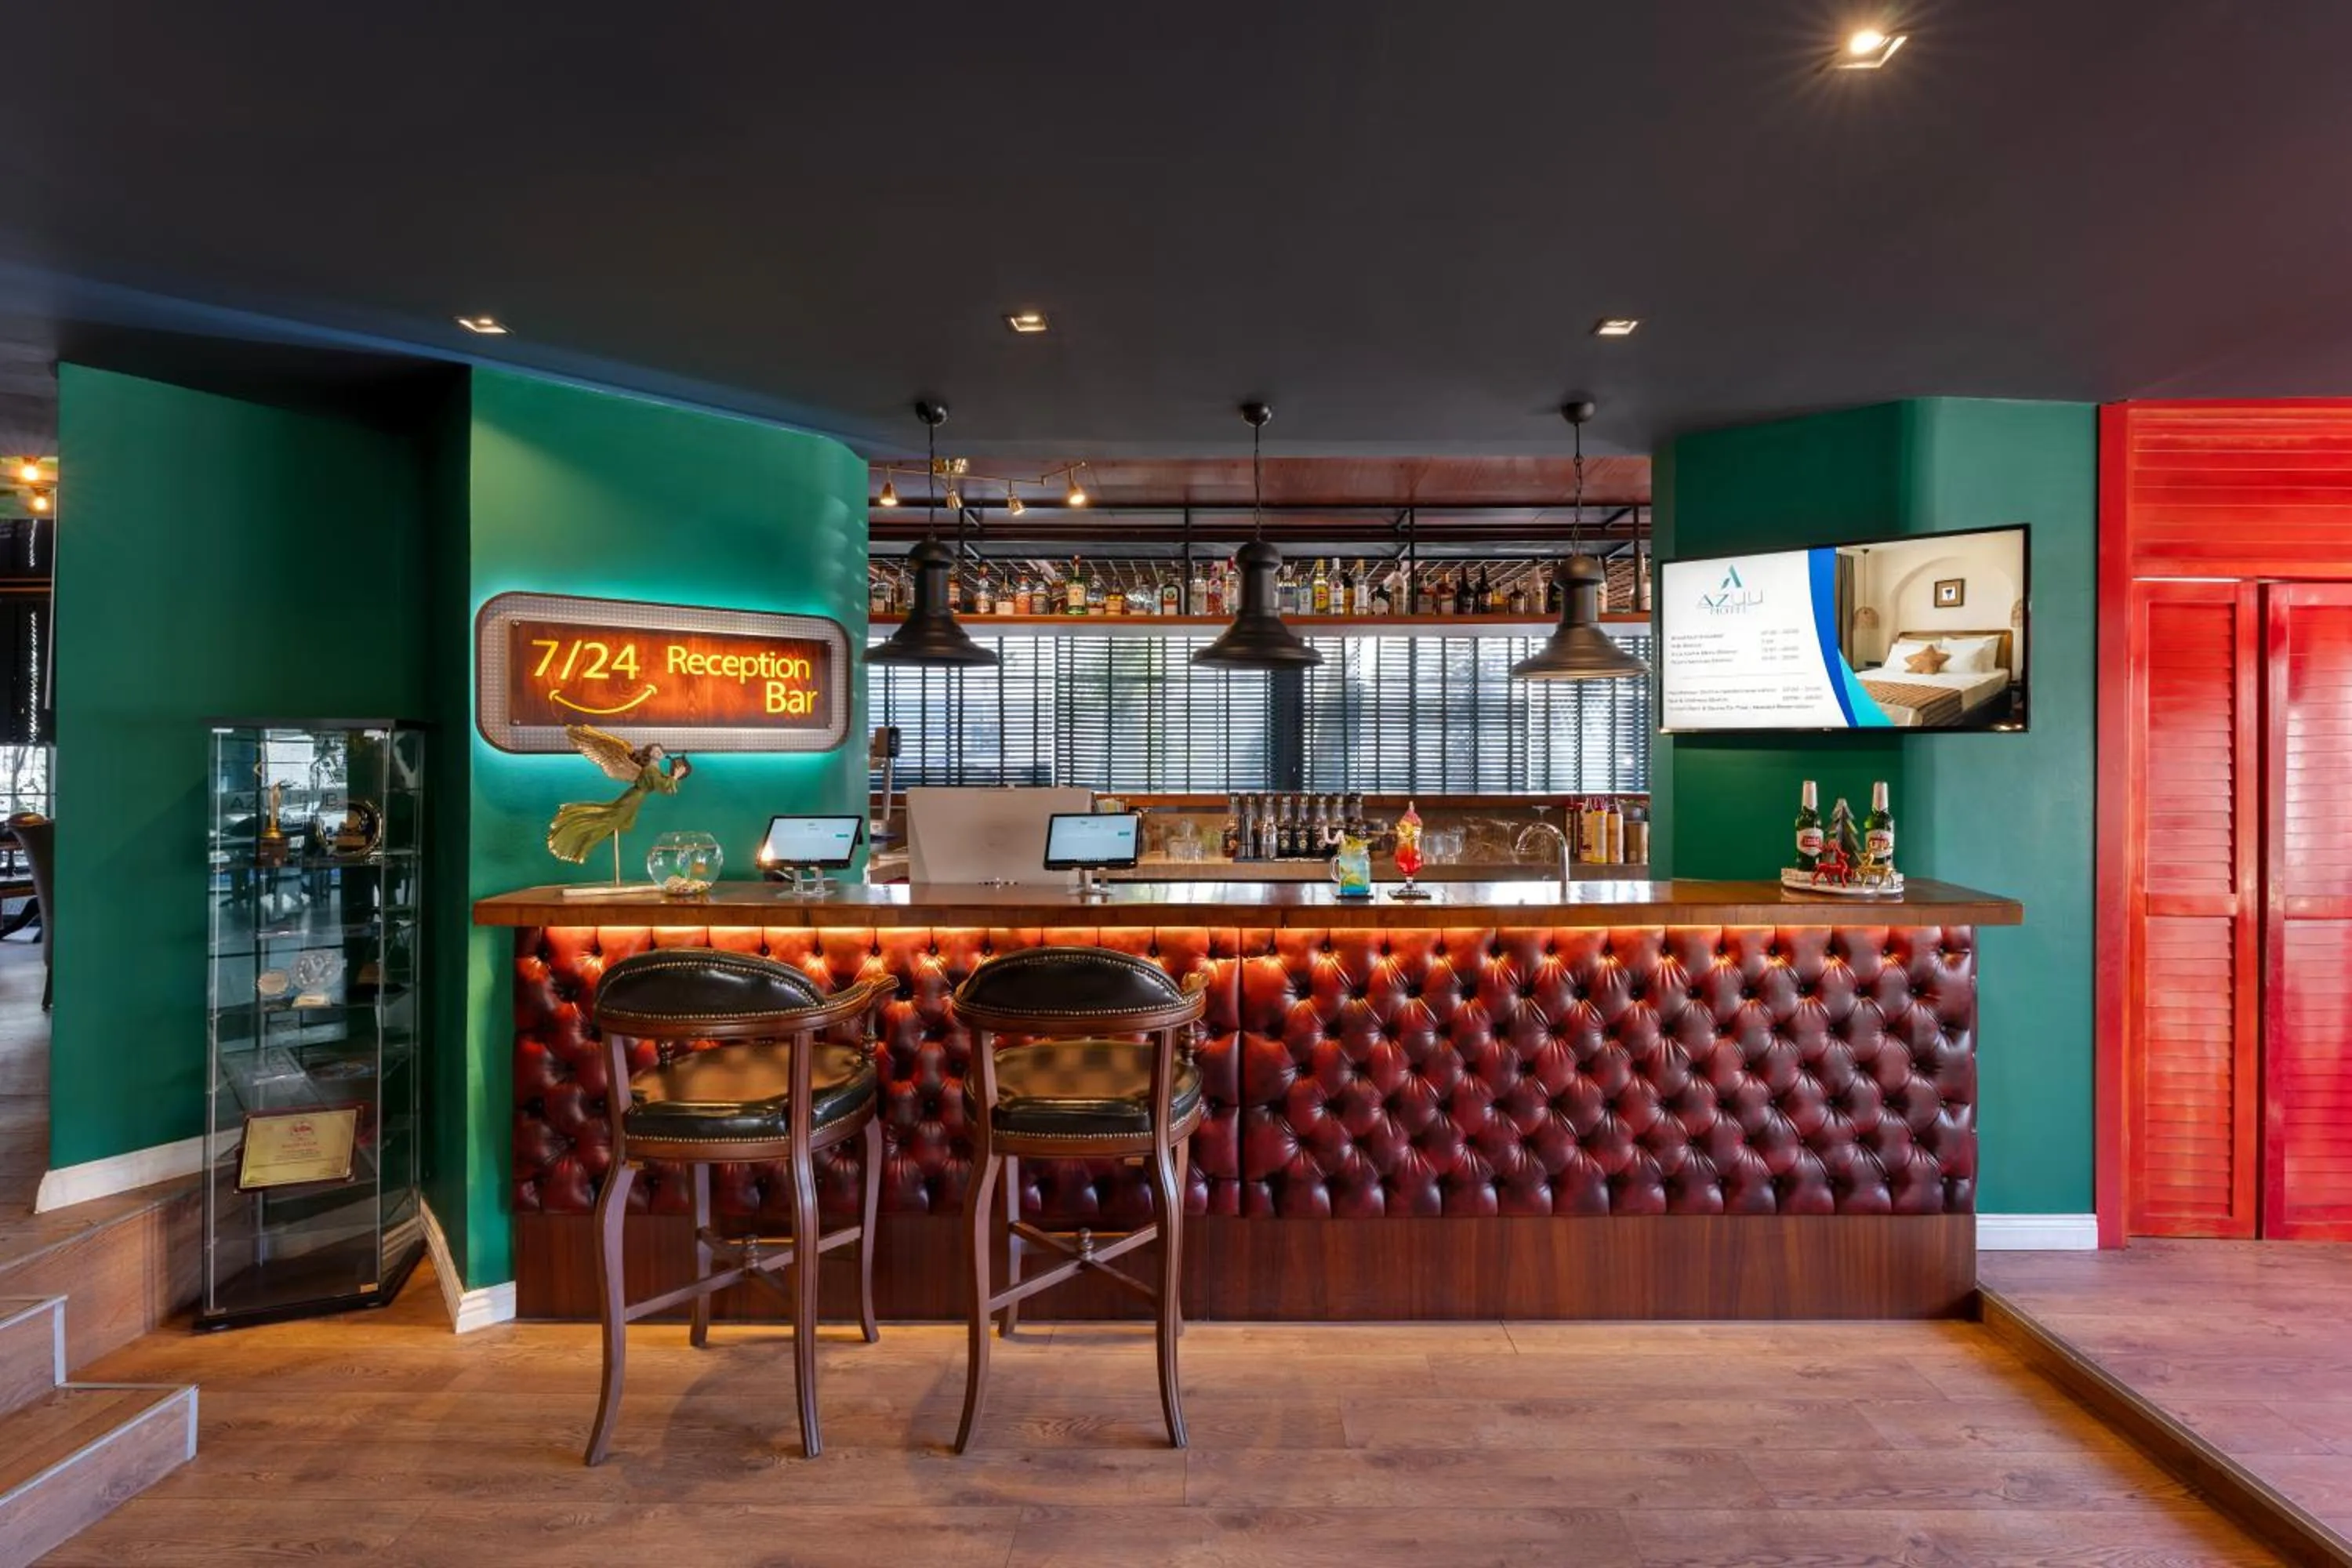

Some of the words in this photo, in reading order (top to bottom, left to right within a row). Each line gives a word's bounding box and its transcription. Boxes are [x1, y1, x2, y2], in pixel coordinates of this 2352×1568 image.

[531, 639, 640, 681] 7/24
[666, 645, 811, 684] Reception
[765, 681, 818, 715] Bar
